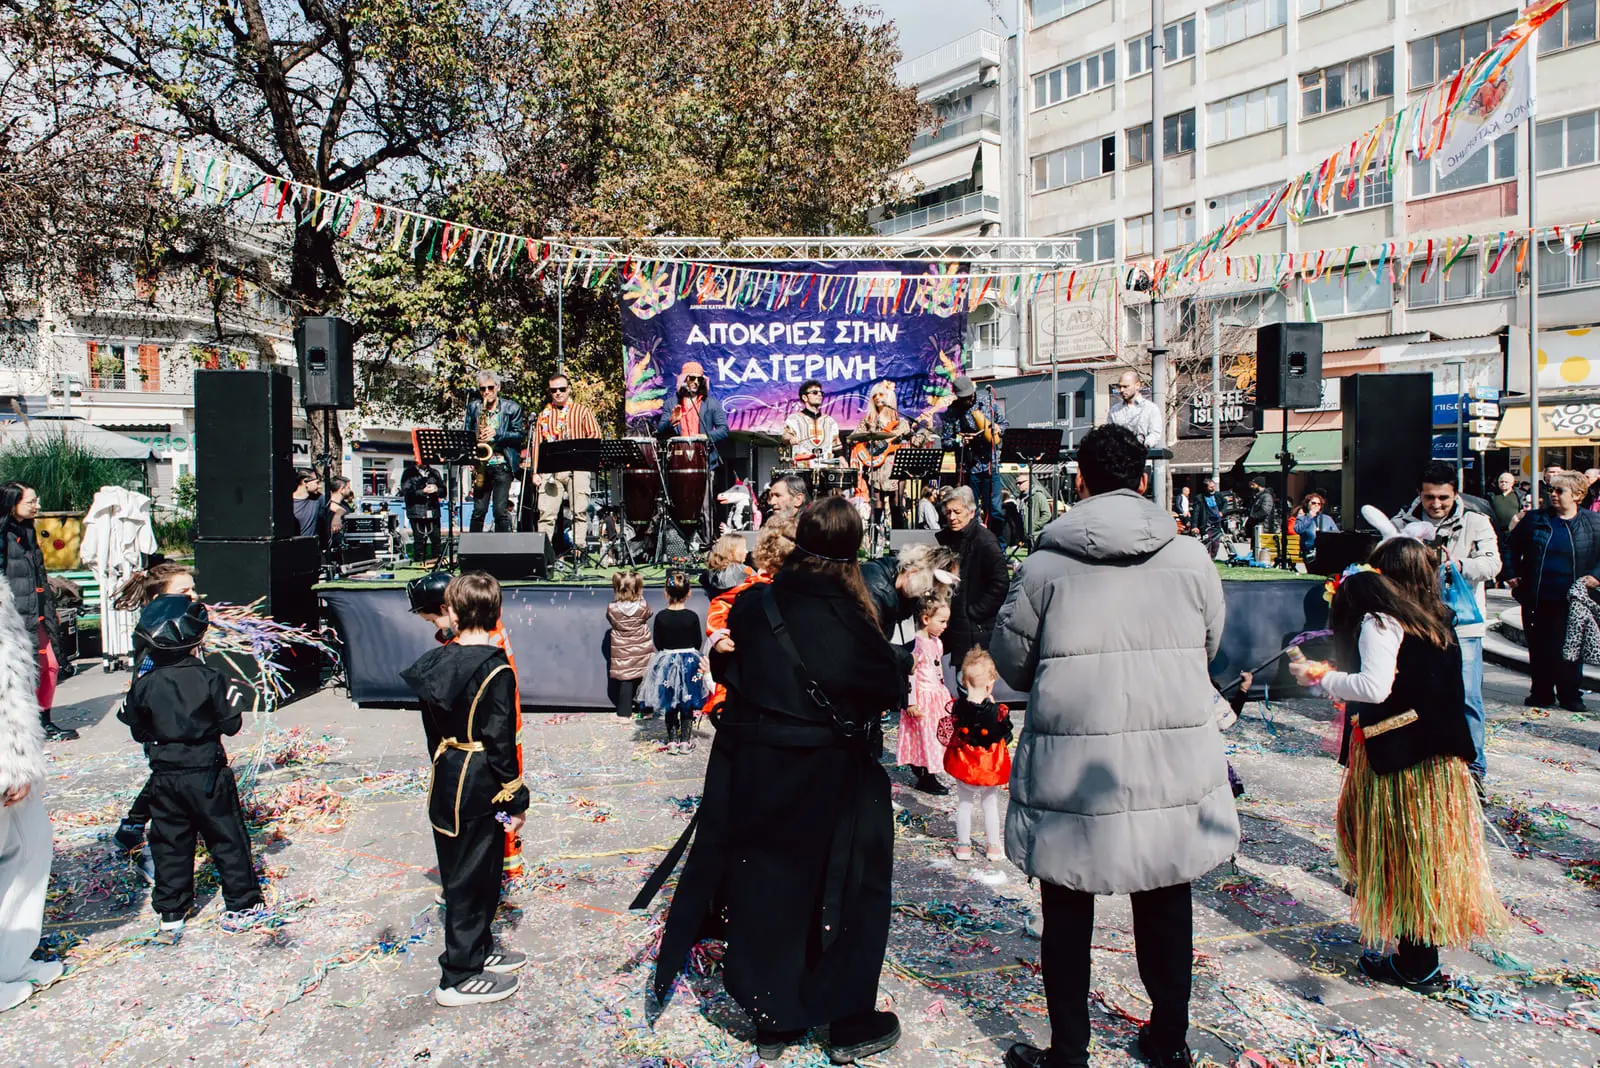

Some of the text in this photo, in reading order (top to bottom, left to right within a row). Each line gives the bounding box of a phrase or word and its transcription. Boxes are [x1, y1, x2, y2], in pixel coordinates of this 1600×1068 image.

[686, 320, 899, 346] ΑΠΟΚΡΙΕΣ ΣΤΗΝ
[716, 354, 877, 384] ΚΑΤΕΡΙΝΗ
[1193, 391, 1243, 407] COFEE
